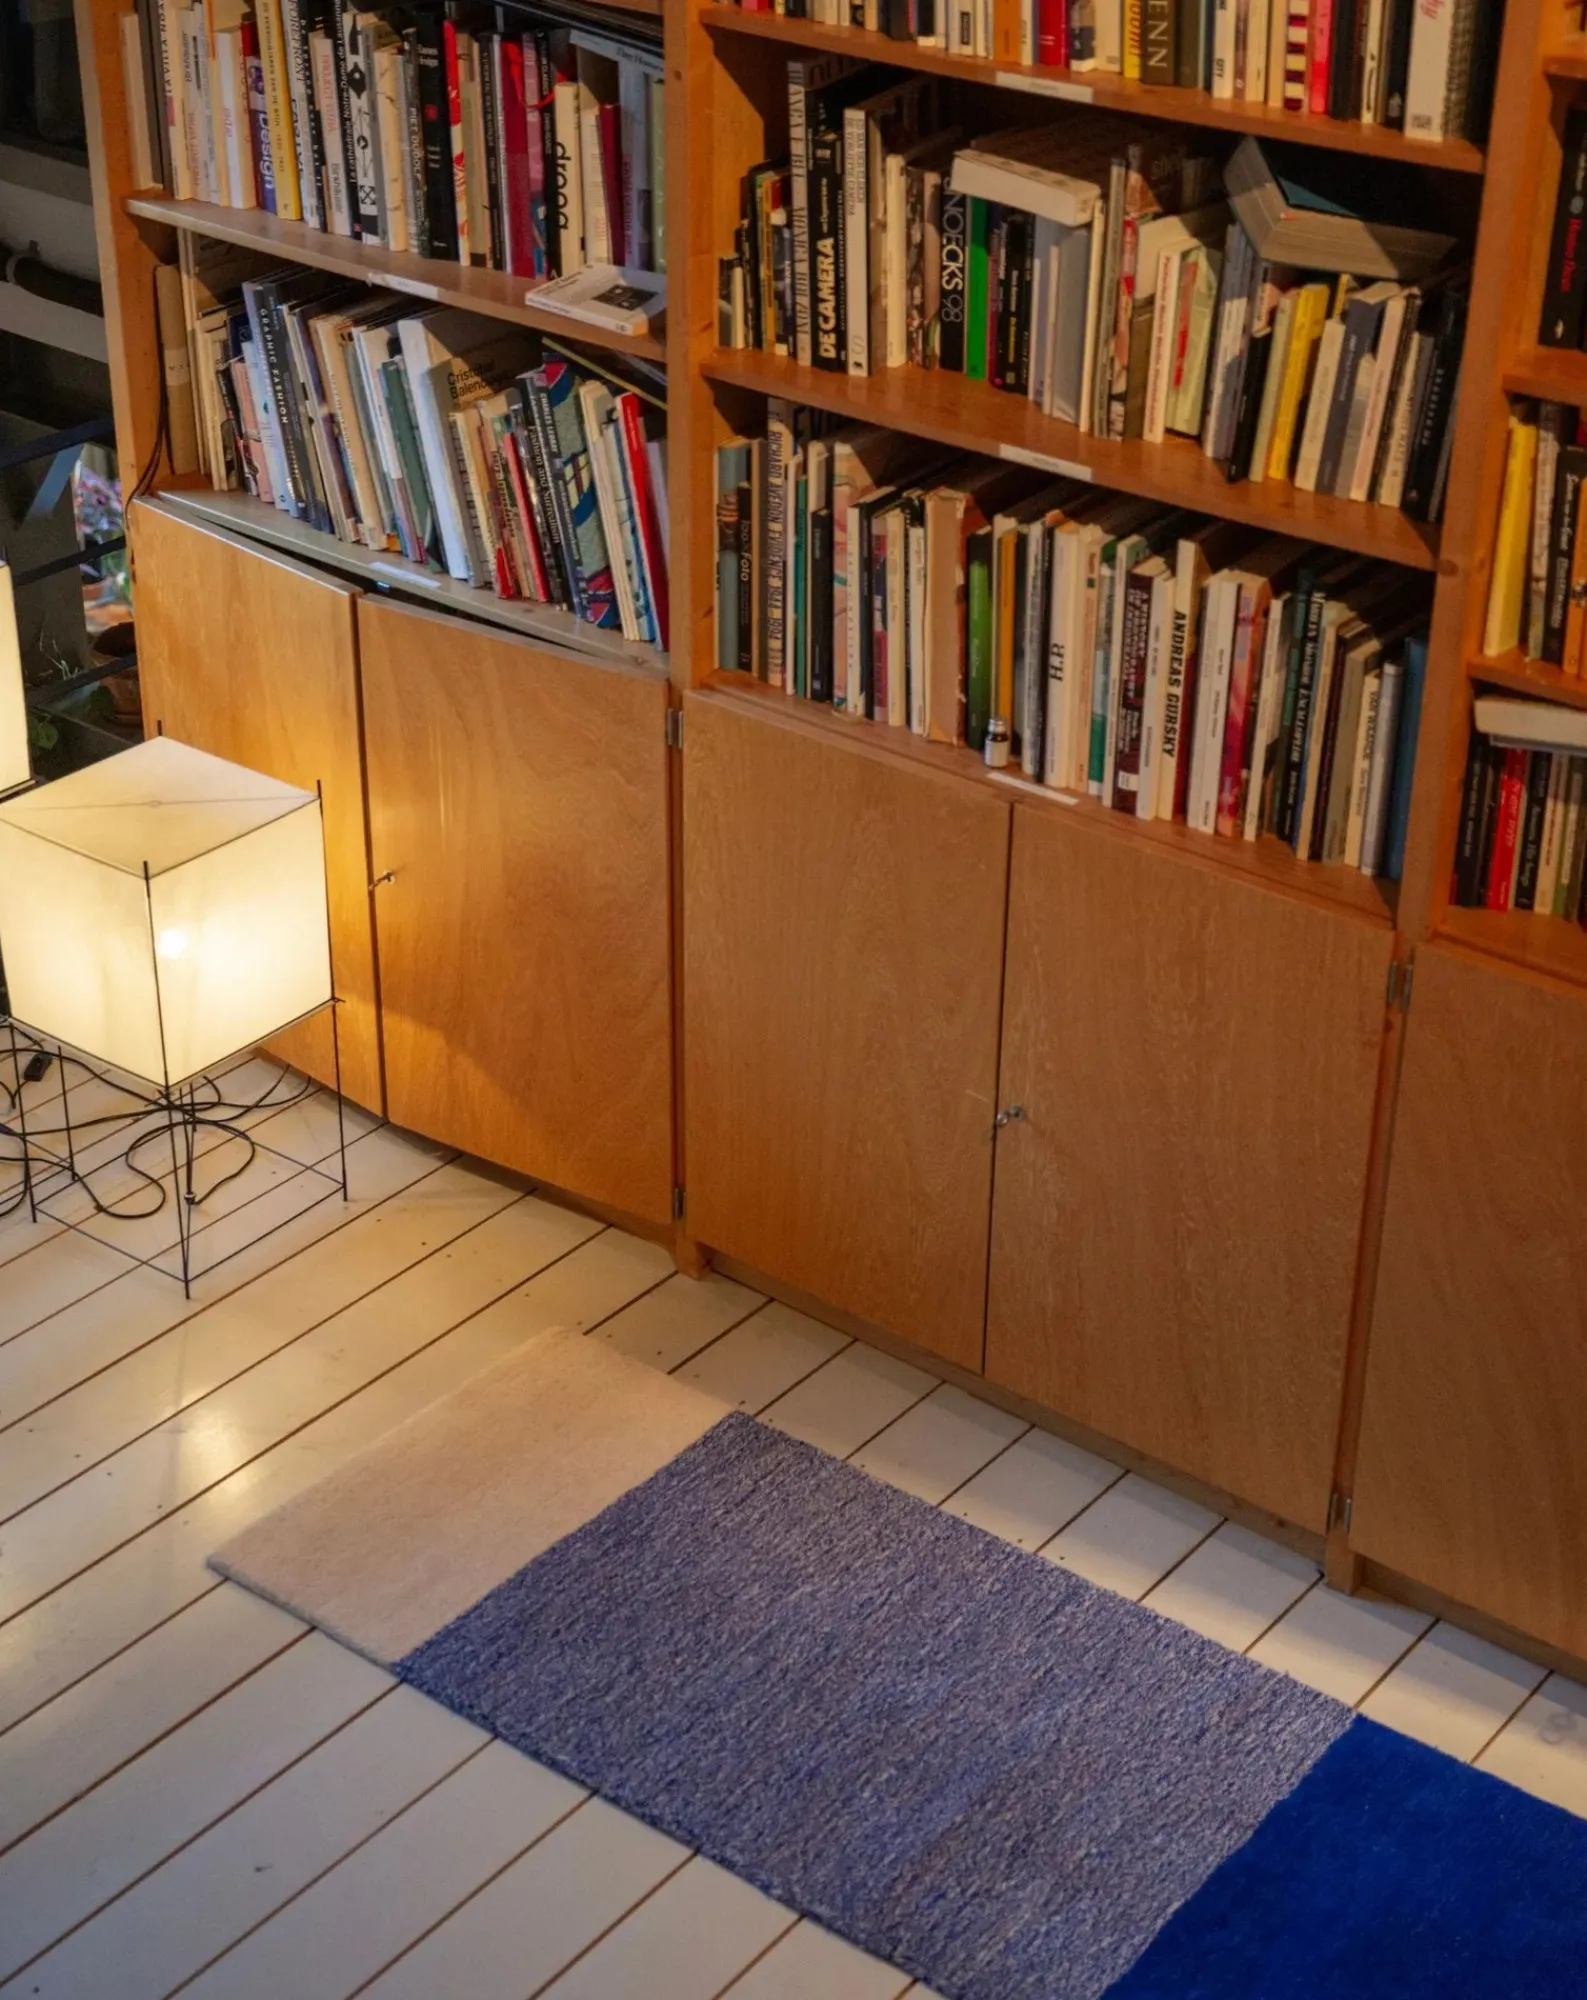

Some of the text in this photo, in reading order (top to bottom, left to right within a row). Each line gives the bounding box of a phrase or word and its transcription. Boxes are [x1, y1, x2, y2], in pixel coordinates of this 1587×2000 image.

[815, 237, 836, 325] CAMERA
[942, 294, 963, 322] 98
[259, 307, 277, 363] GRAPHIC
[271, 369, 289, 425] FASHION
[817, 329, 837, 358] DE
[527, 425, 547, 466] Fashion
[768, 430, 784, 478] RICHARD
[534, 468, 551, 487] and
[768, 482, 784, 524] AVEDON
[768, 527, 784, 580] EVIDENCE
[1162, 610, 1187, 758] ANDREAS GURSKY
